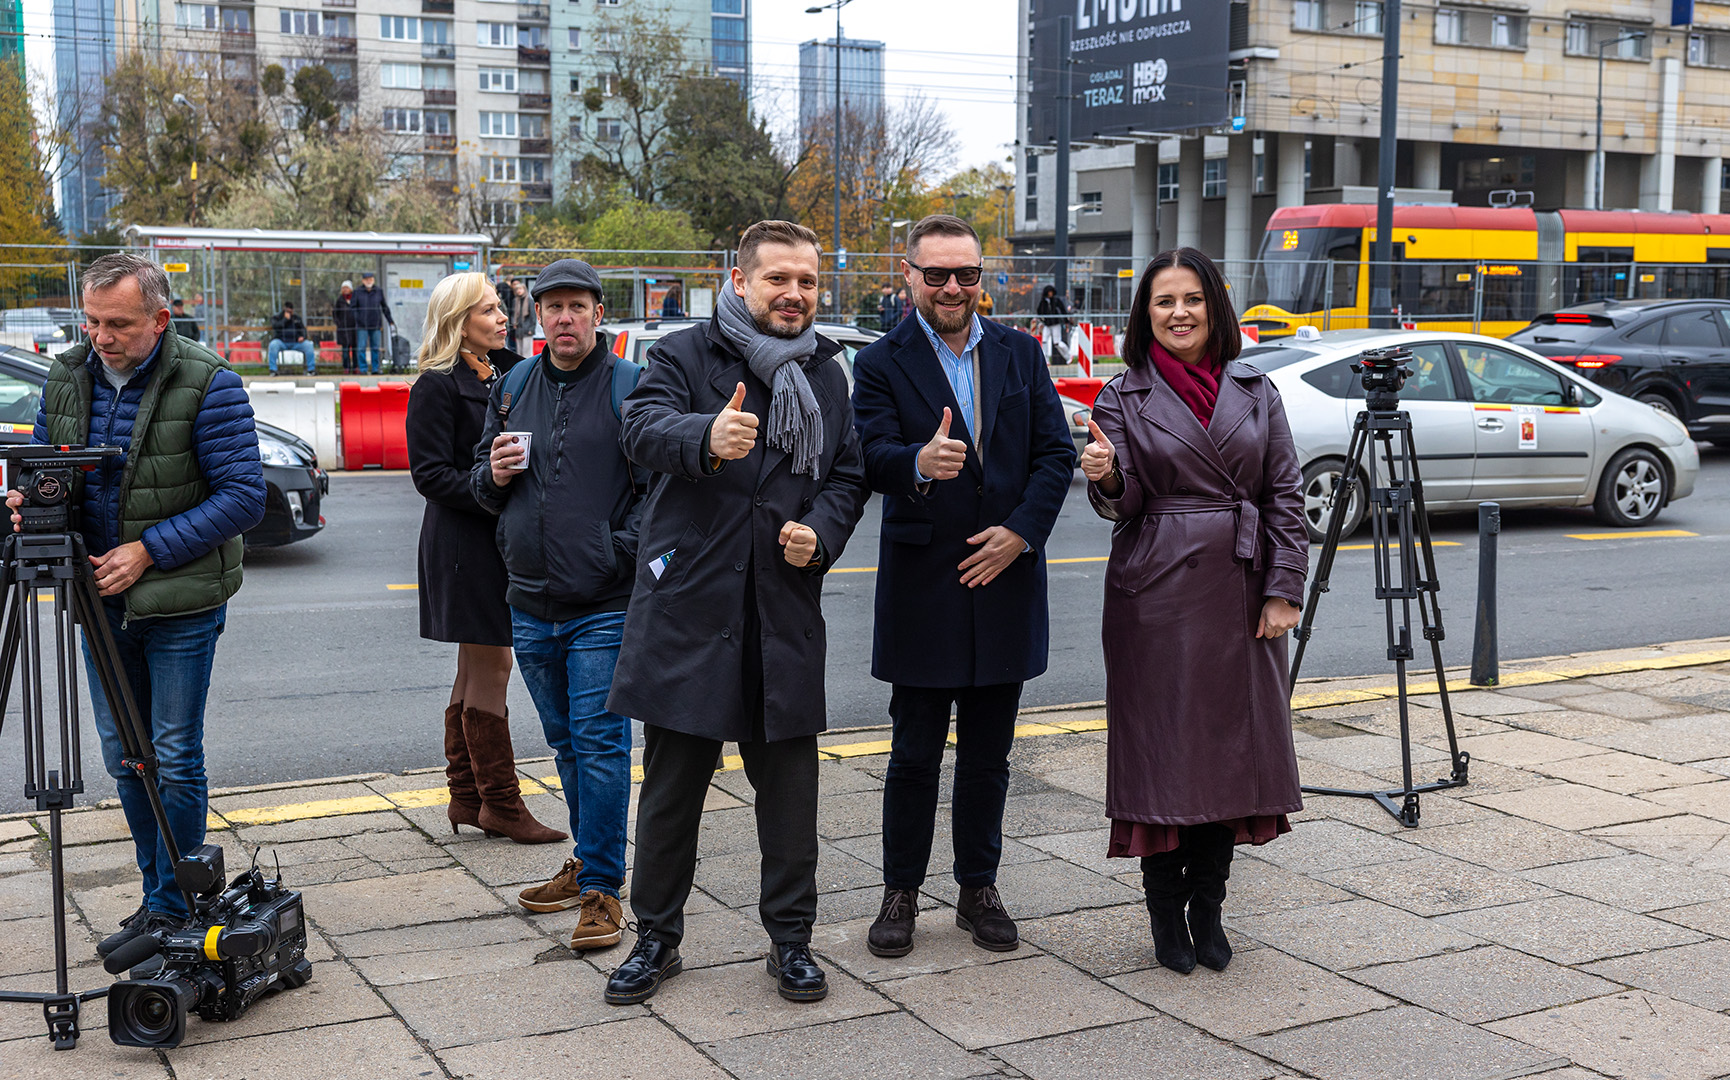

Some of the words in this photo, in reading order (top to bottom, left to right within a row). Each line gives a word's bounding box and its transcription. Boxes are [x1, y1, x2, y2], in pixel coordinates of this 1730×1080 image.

[1069, 30, 1118, 52] RZESZŁOŚĆ
[1119, 29, 1134, 44] NIE
[1135, 19, 1191, 41] ODPUSZCZA
[1133, 58, 1168, 88] HBO
[1083, 85, 1124, 108] TERAZ
[1133, 84, 1166, 105] max
[1283, 230, 1299, 249] 24
[1297, 329, 1310, 338] TAXI
[0, 424, 13, 432] 60
